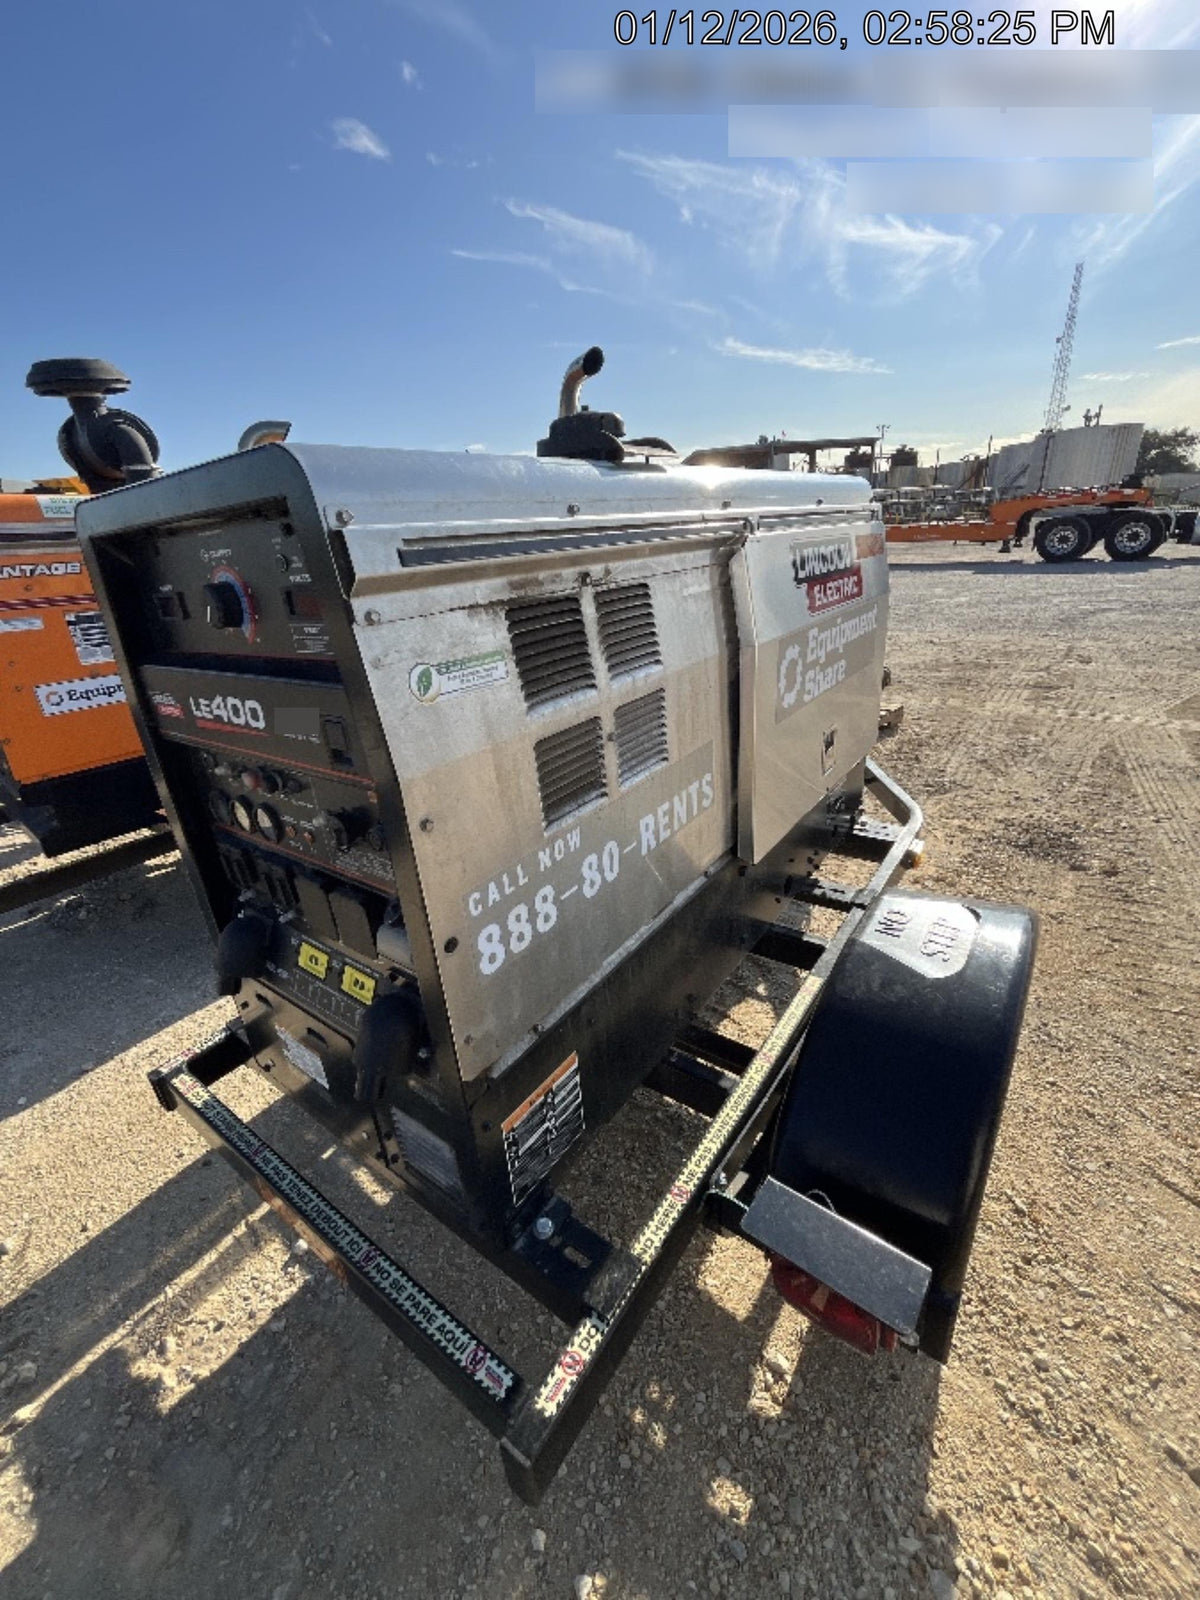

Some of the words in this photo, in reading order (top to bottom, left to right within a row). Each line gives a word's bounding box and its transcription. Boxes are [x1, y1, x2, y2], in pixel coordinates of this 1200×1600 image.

[806, 604, 878, 664] Equipment
[803, 658, 847, 703] Share
[189, 693, 266, 730] LE400
[468, 862, 529, 917] CALL
[538, 826, 582, 872] NOW
[477, 772, 714, 976] 888-80-RENTS
[650, 1201, 678, 1235] HERE
[346, 1237, 363, 1255] ICI
[373, 1264, 391, 1281] NO
[389, 1276, 407, 1296] SE
[404, 1293, 437, 1326] PARE
[579, 1324, 600, 1349] DO
